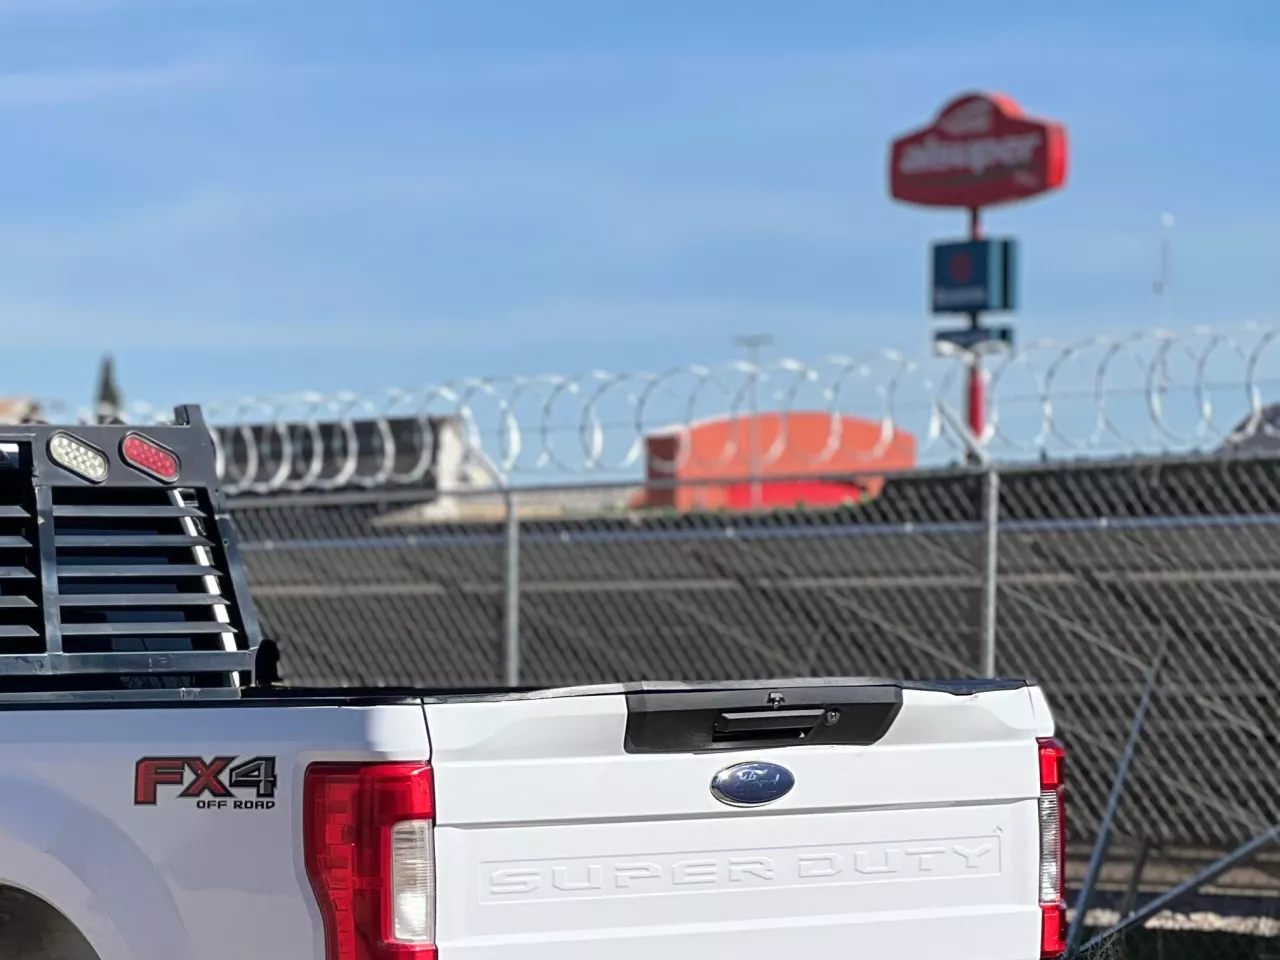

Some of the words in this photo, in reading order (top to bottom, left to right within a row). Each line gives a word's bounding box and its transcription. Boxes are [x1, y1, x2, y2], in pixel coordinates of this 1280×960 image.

[134, 757, 276, 804] FX4
[197, 800, 227, 809] OFF
[234, 800, 275, 809] ROAD
[490, 857, 774, 894] SUPER
[798, 845, 993, 878] DUTY
